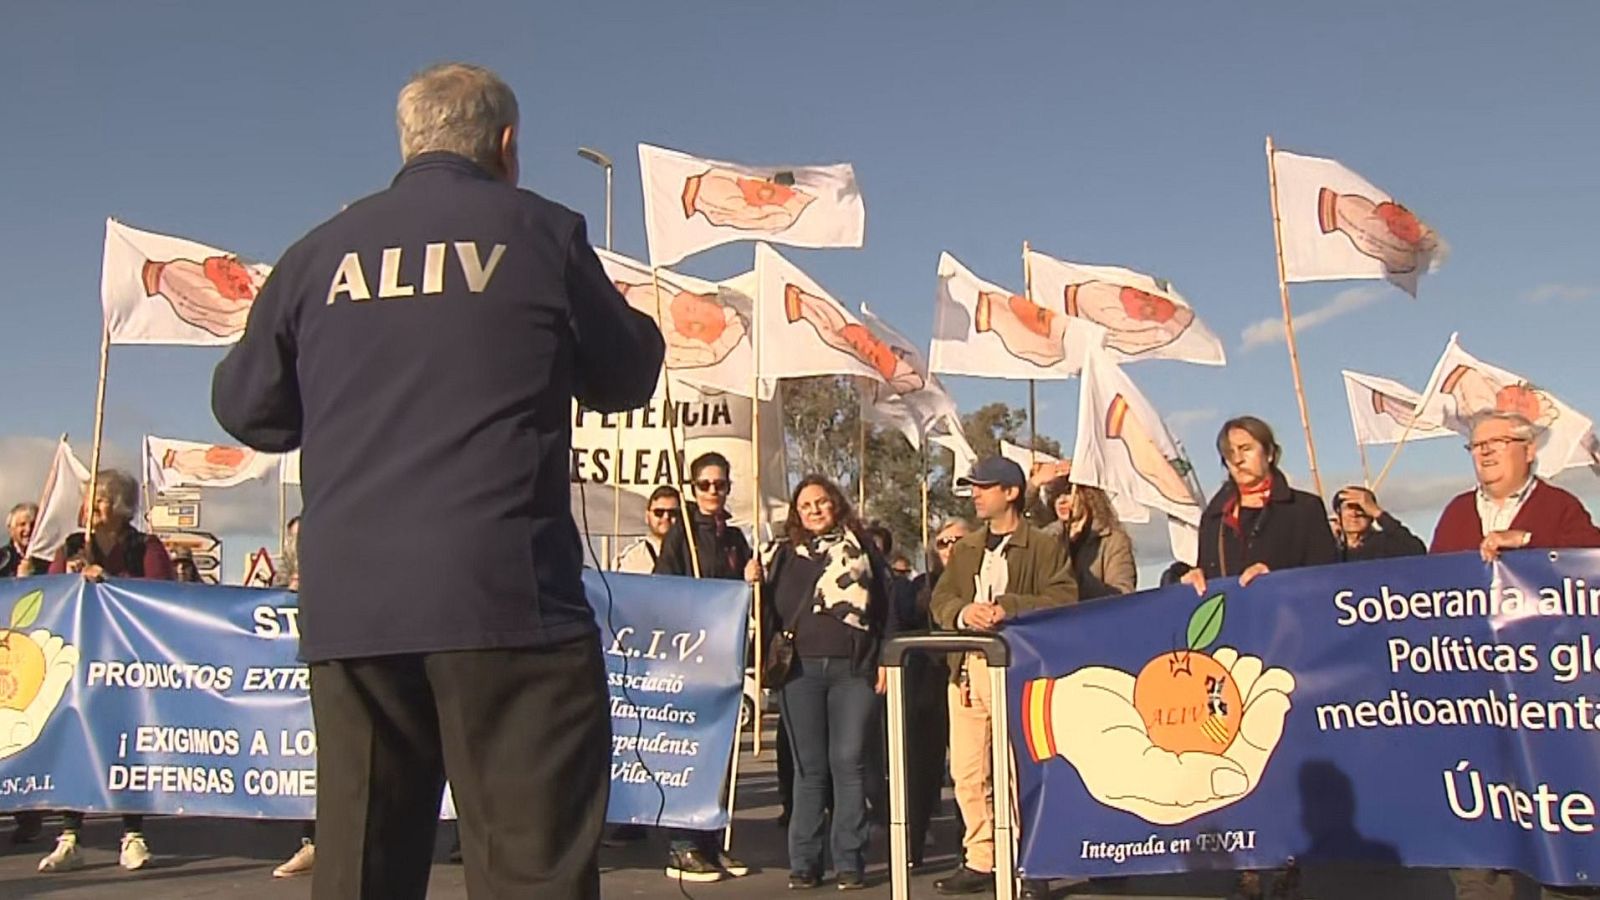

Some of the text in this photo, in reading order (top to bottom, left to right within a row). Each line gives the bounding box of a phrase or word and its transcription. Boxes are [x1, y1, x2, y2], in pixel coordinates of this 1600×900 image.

[326, 242, 507, 305] ALIV
[1334, 582, 1524, 626] Soberanía
[253, 606, 299, 640] ST
[1388, 635, 1538, 673] Políticas
[87, 661, 310, 691] PRODUCTOS EXTR
[136, 726, 239, 756] EXIGIMOS
[250, 730, 269, 756] A
[281, 730, 318, 756] LO
[612, 732, 699, 757] pendents
[109, 765, 316, 796] DEFENSAS COME
[1443, 760, 1595, 833] Únete
[1080, 830, 1256, 863] Integrada en FNAI
